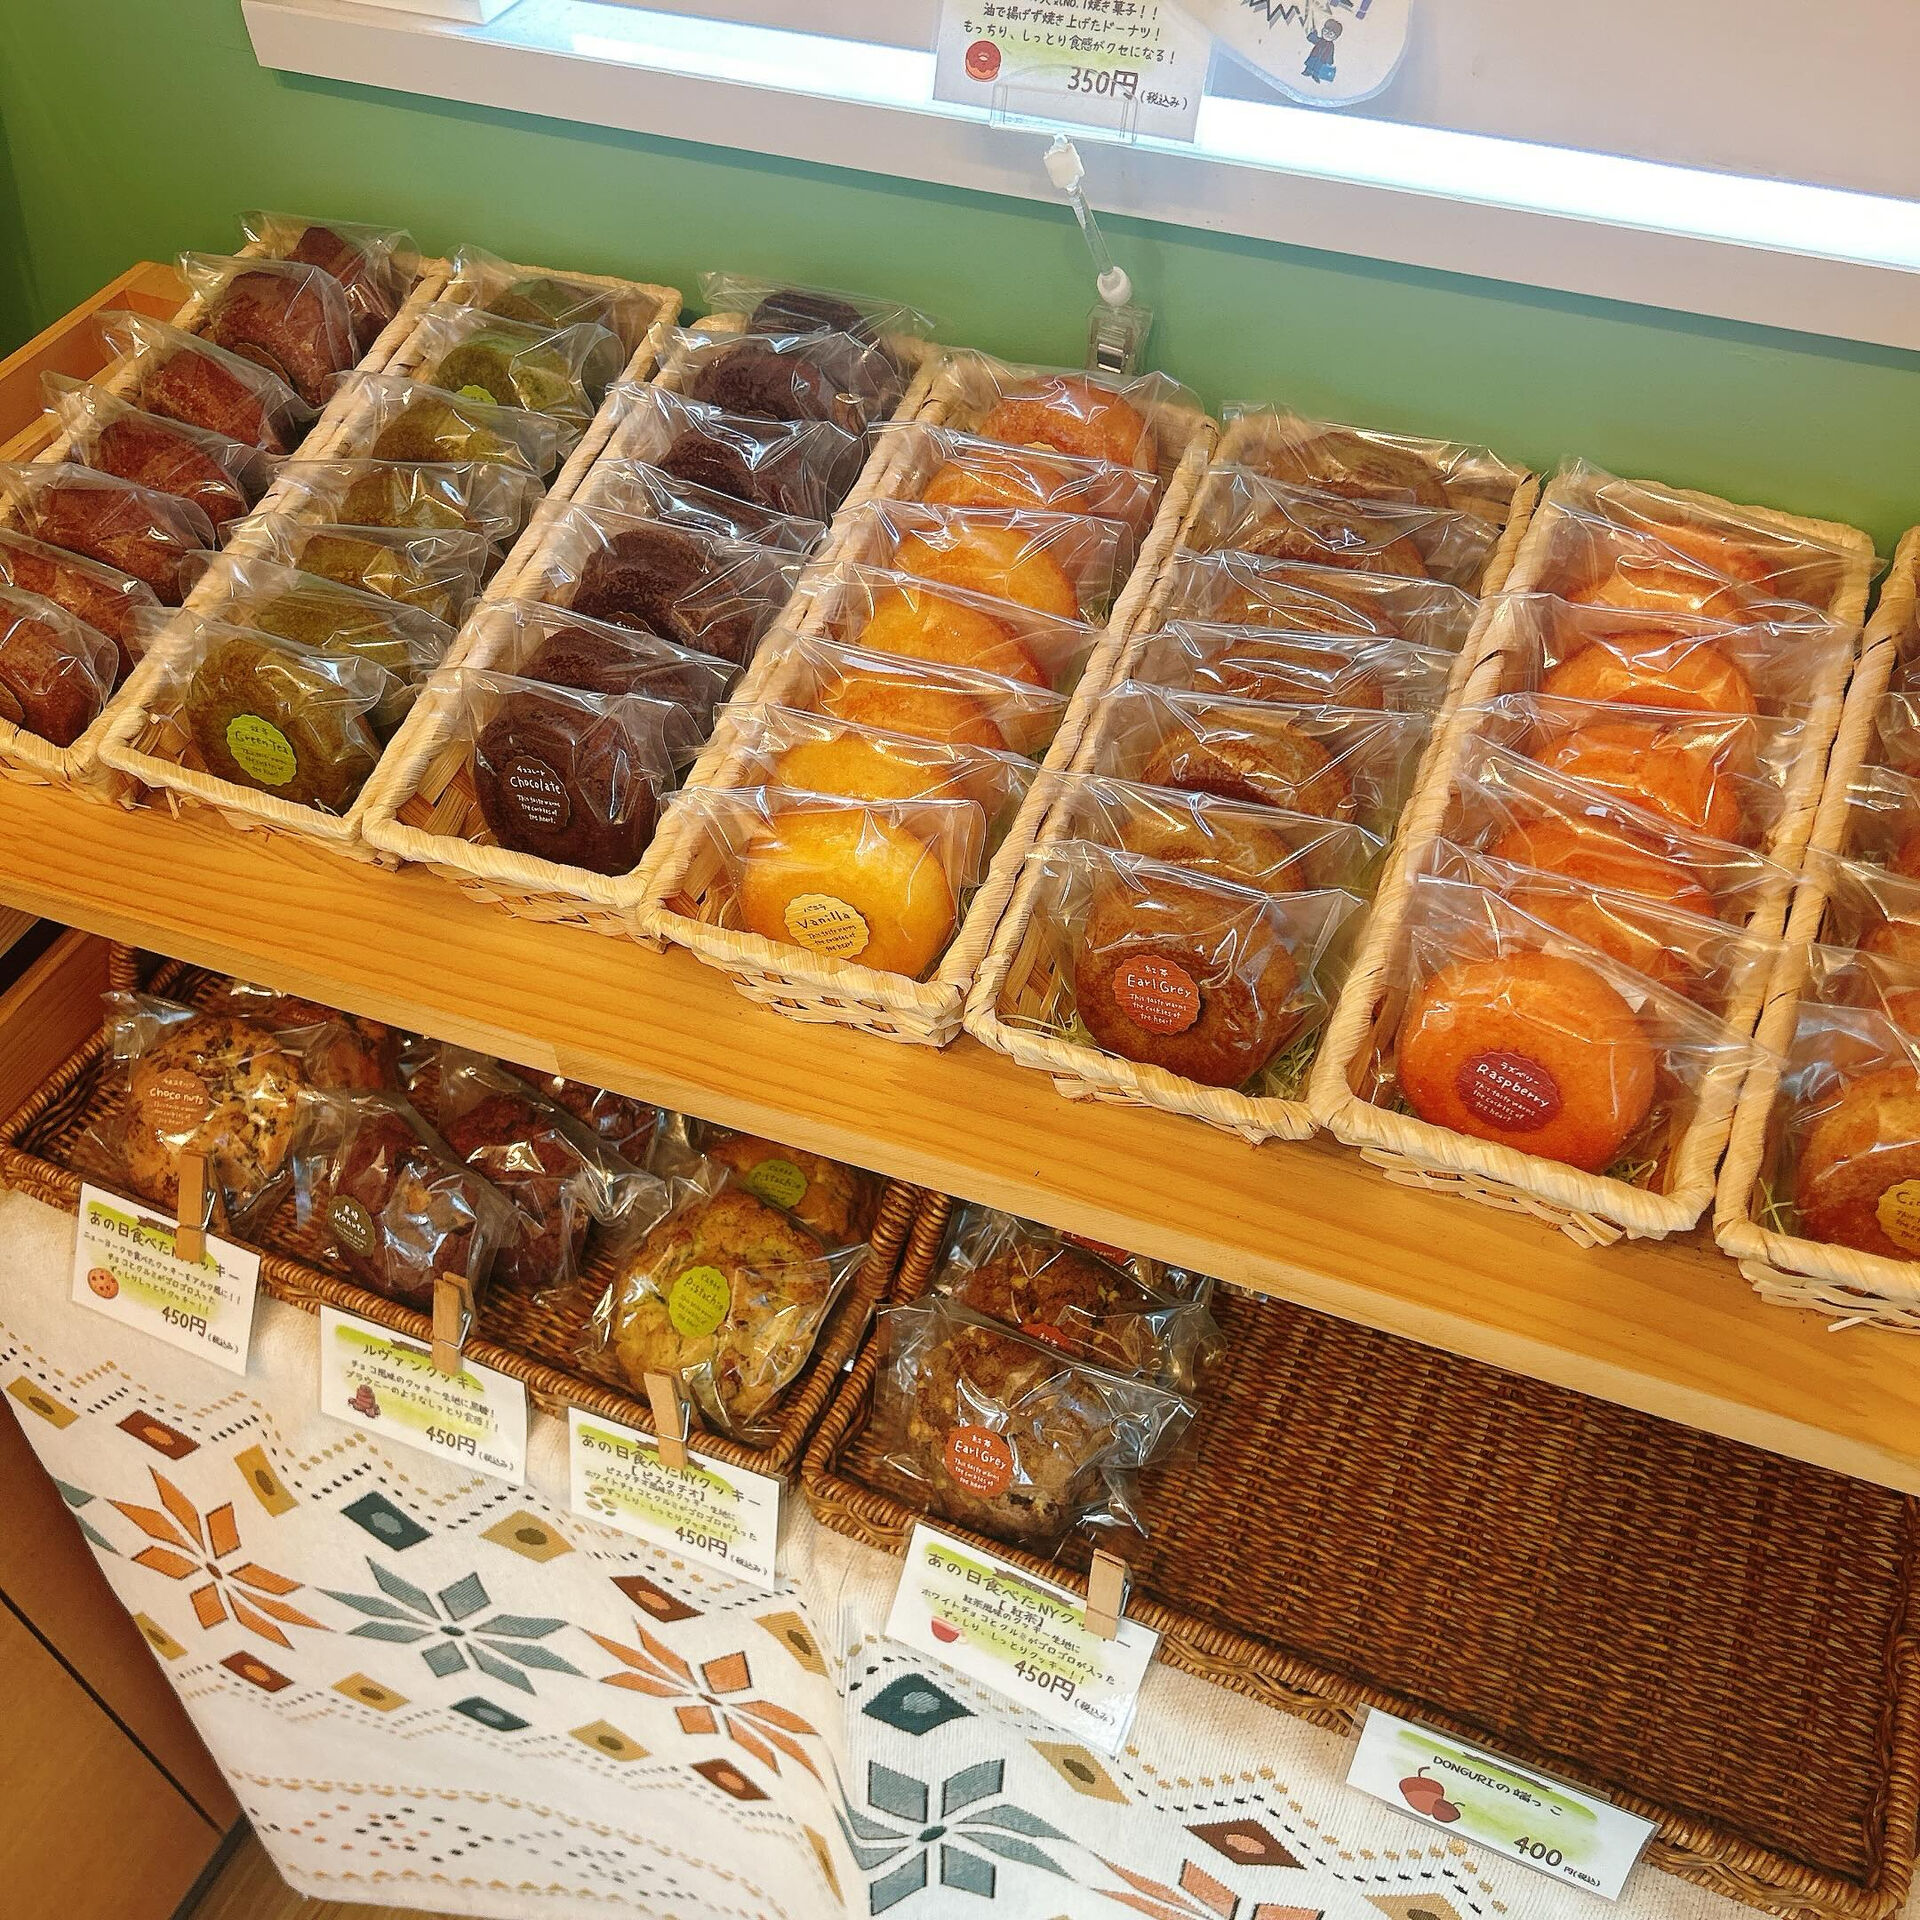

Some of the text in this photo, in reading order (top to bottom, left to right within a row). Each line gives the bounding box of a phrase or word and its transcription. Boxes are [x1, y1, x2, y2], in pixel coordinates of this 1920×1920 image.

[983, 3, 1161, 41] 油で揚げず焼き上げたドーナツ！
[963, 20, 1176, 65] もっちり、しっとり食感がクセになる！
[1067, 67, 1139, 100] 350円
[510, 776, 561, 794] Chocolate
[796, 910, 851, 930] Vanilla
[1127, 974, 1191, 998] Earl Grey
[149, 1087, 181, 1100] Choco
[1476, 1063, 1550, 1108] Raspberry
[162, 1305, 207, 1338] 450円
[425, 1425, 476, 1457] 450円
[954, 1440, 1007, 1470] Earl Grey
[674, 1526, 728, 1558] 450円
[962, 1593, 1081, 1654] 紅茶風味のクッキー生地に
[999, 1599, 1045, 1628] 【紅茶】
[1014, 1659, 1077, 1702] 450円
[1432, 1754, 1563, 1817] DONGURIの端っこ
[1513, 1835, 1563, 1867] 400
